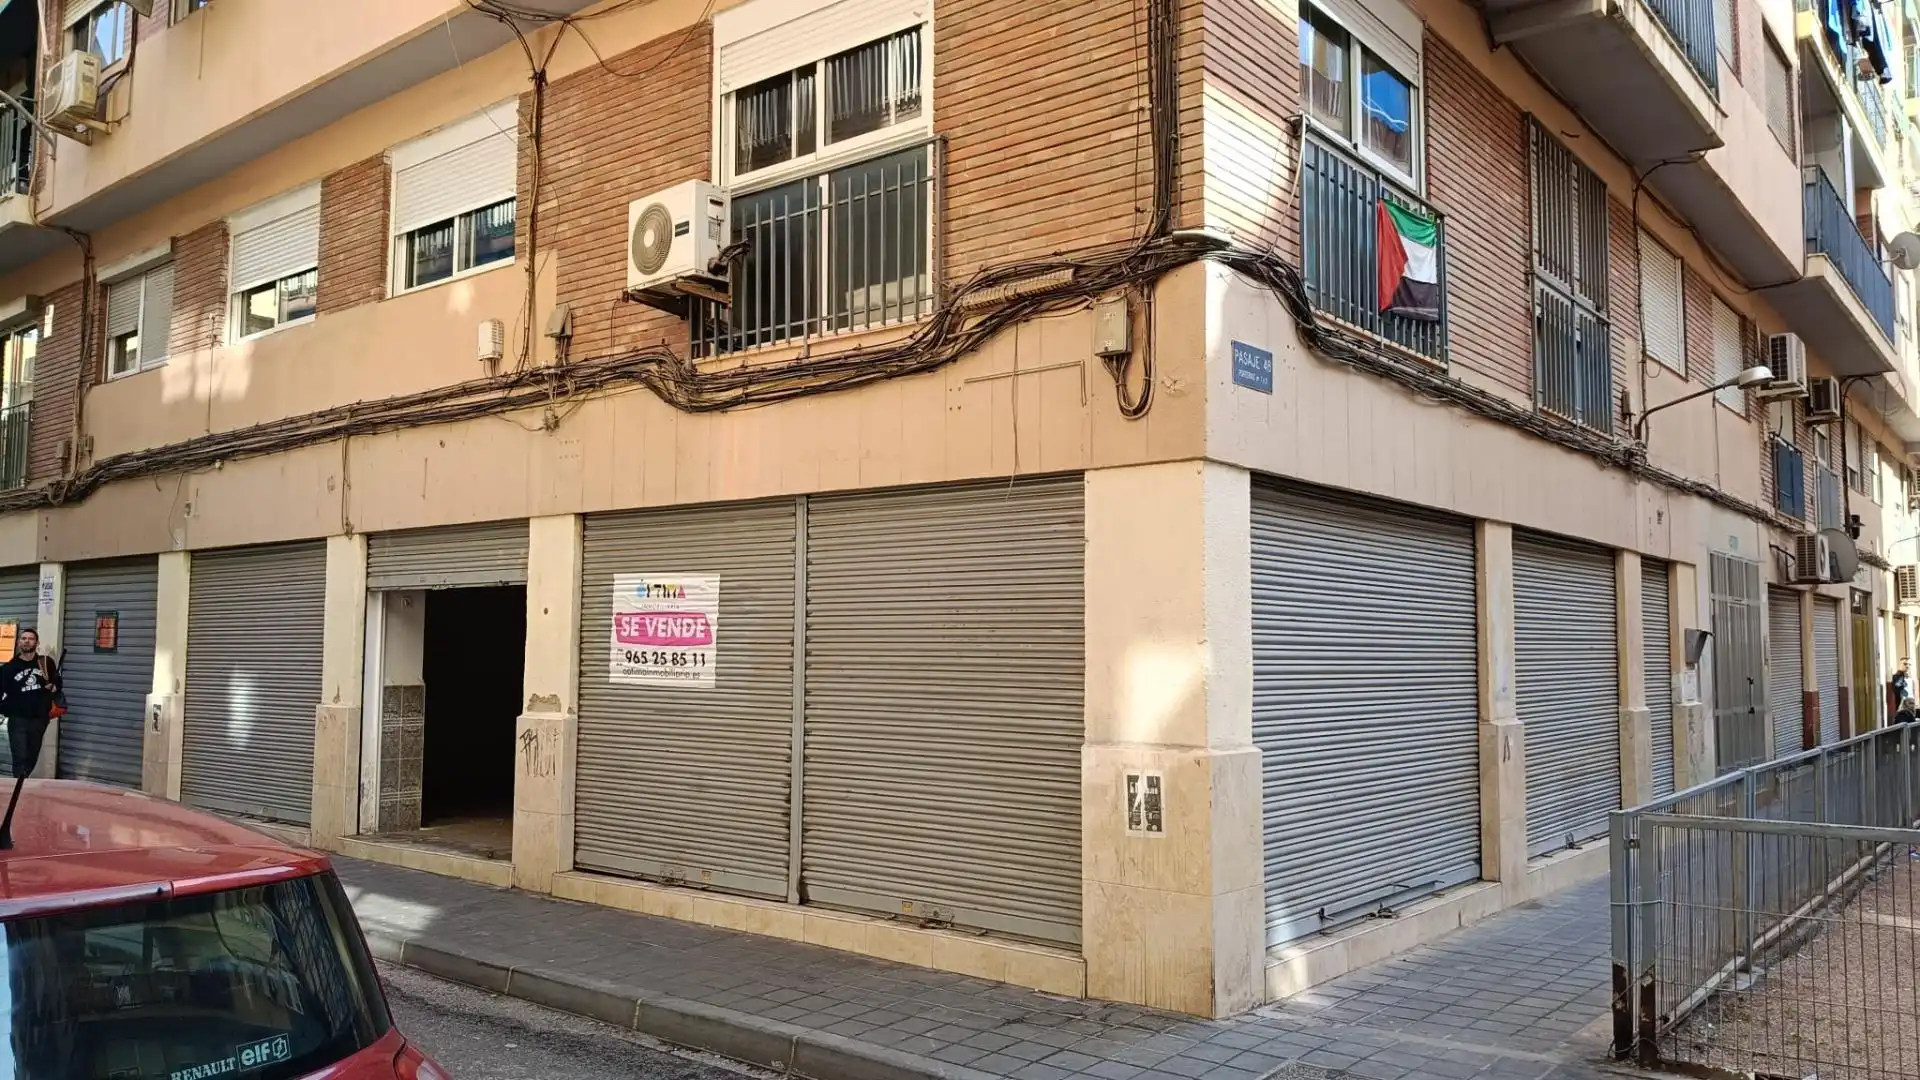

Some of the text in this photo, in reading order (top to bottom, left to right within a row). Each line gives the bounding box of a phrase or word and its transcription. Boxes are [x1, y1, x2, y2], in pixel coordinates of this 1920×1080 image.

[1235, 349, 1260, 370] PASAJE
[620, 616, 706, 639] SE VENDE
[625, 650, 706, 668] 965 25 85 11
[170, 1042, 271, 1080] RENAULT elf
